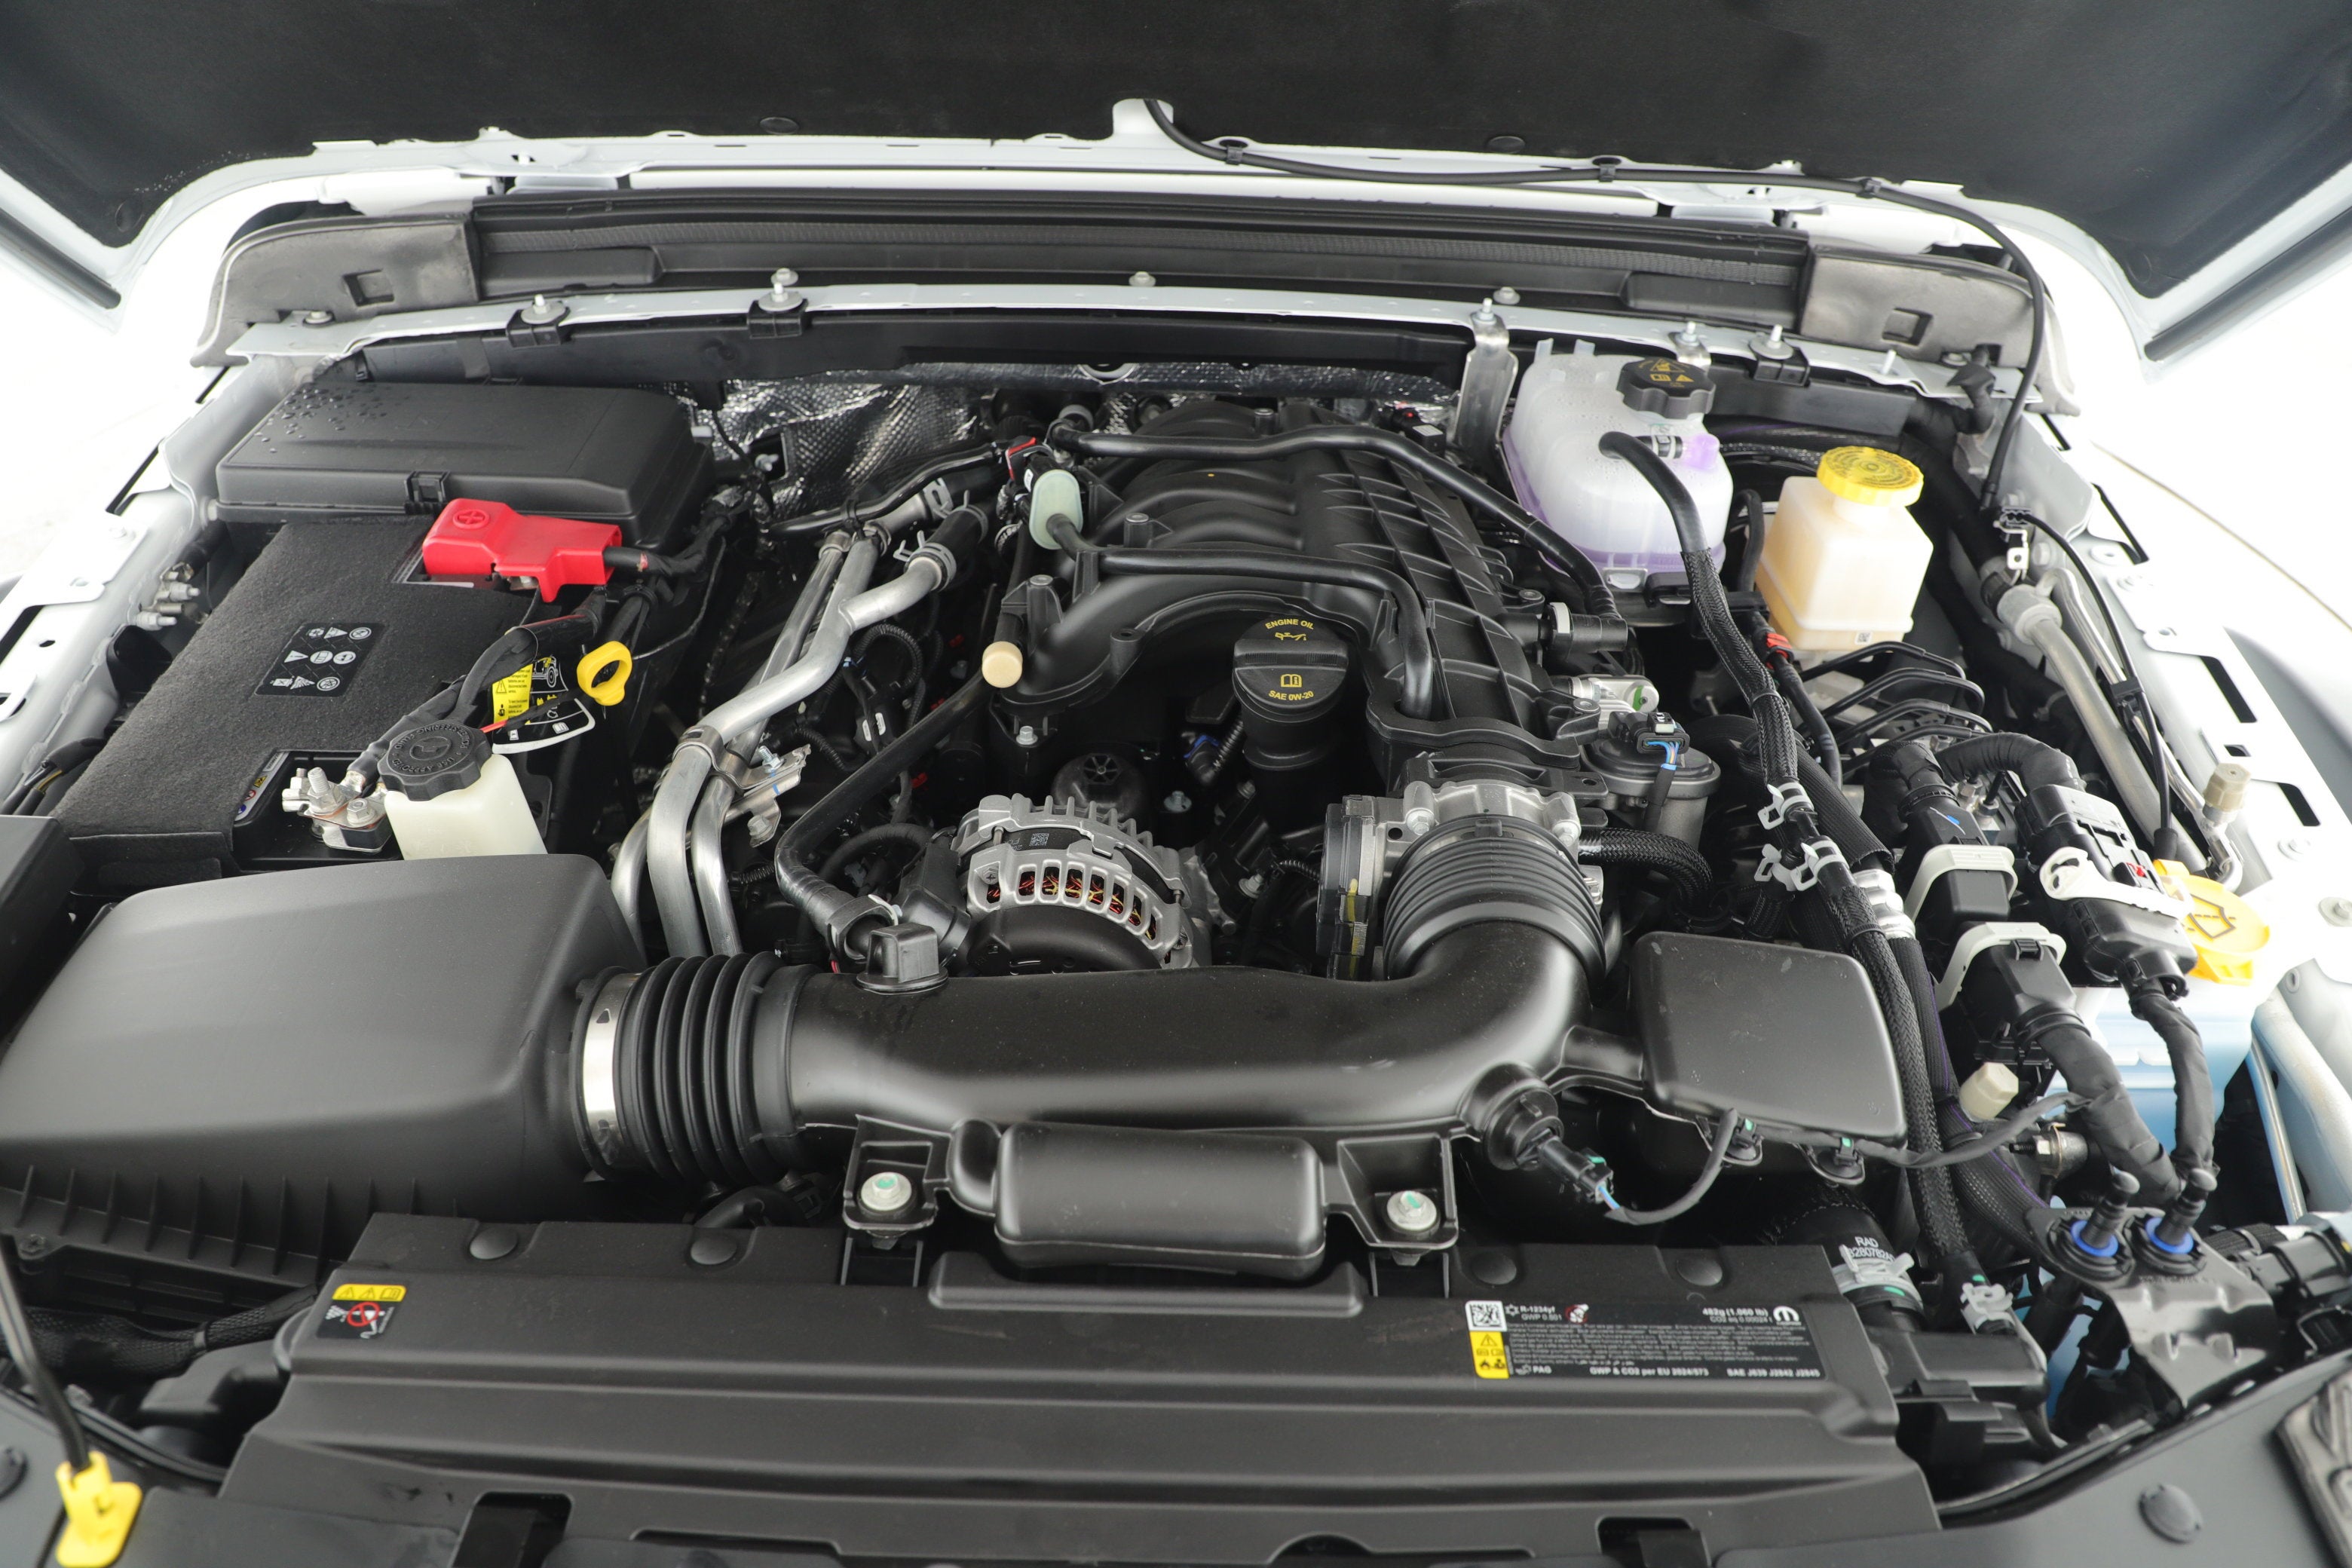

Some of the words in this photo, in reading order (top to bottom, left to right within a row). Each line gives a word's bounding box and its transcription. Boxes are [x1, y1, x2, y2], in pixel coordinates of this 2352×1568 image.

[1265, 619, 1298, 629] ENGINE
[1300, 620, 1315, 629] OIL
[1268, 690, 1286, 700] SAE
[1288, 691, 1315, 701] 0W-20
[416, 724, 458, 734] STEERING
[394, 733, 415, 749] FLUID
[436, 757, 455, 767] USE
[1854, 1236, 1879, 1248] RAD
[1520, 1306, 1555, 1314] R-1234yf
[1533, 1365, 1552, 1374] PAG
[1589, 1366, 1611, 1375] GWP
[1621, 1367, 1640, 1375] CO2
[1726, 1367, 1746, 1377] SAE
